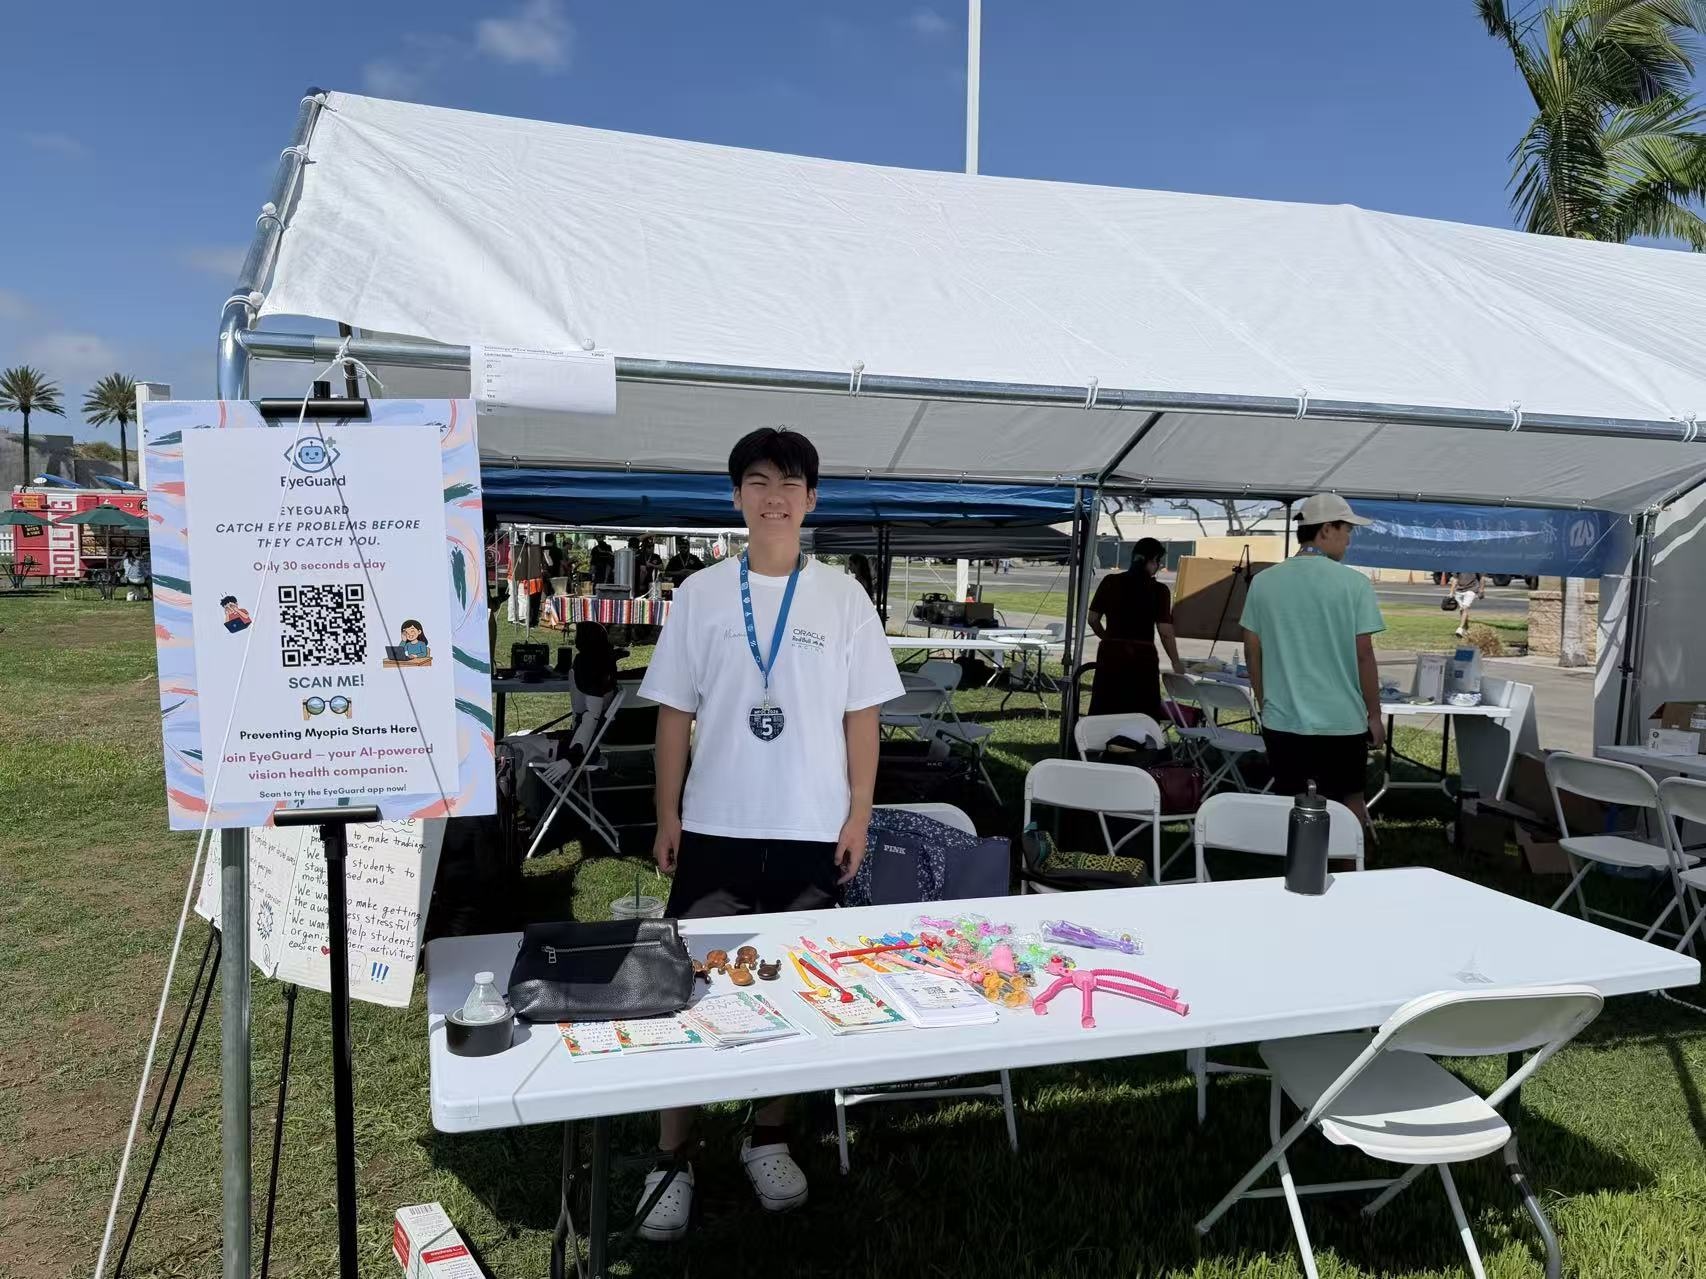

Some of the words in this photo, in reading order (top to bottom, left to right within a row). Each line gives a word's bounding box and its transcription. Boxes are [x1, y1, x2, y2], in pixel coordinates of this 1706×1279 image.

[280, 474, 346, 490] EyeGuard
[280, 505, 350, 516] EYEGUARD
[215, 523, 263, 533] CATCH
[267, 522, 292, 533] EYE
[296, 520, 367, 531] PROBLEMS
[371, 519, 421, 530] BEFORE
[257, 537, 292, 548] THEY
[295, 536, 343, 547] CATCH
[349, 535, 381, 546] YOU.
[282, 560, 298, 571] 30
[300, 559, 350, 571] seconds
[352, 561, 361, 569] a
[364, 558, 386, 571] day
[793, 628, 825, 642] ORACLE
[288, 675, 333, 689] SCAN
[336, 673, 365, 687] ME!
[239, 729, 302, 741] Preventing
[304, 727, 349, 740] Myopia
[351, 725, 387, 736] Starts
[390, 724, 418, 734] Here
[761, 717, 773, 737] 5
[222, 751, 246, 763] Join
[249, 748, 312, 765] EyeGuard
[327, 749, 357, 762] your
[359, 743, 434, 759] AI-powered
[248, 767, 287, 780] vision
[289, 766, 330, 779] health
[333, 764, 408, 778] companion.
[259, 789, 282, 799] Scan
[283, 790, 292, 798] to
[293, 789, 306, 799] try
[307, 788, 321, 797] the
[323, 785, 365, 798] EyeGuard
[367, 786, 384, 796] app
[386, 783, 407, 793] now!
[354, 830, 362, 840] to
[367, 832, 389, 844] make
[883, 844, 906, 855] PINK
[306, 846, 320, 860] We
[352, 858, 396, 875] students
[404, 867, 415, 878] to
[366, 874, 385, 886] and
[294, 895, 308, 909] the
[346, 912, 361, 922] ess
[297, 881, 311, 896] We
[356, 896, 378, 911] make
[381, 905, 422, 927] getting
[291, 908, 305, 925] We
[371, 929, 415, 948] students
[370, 944, 415, 962] activities
